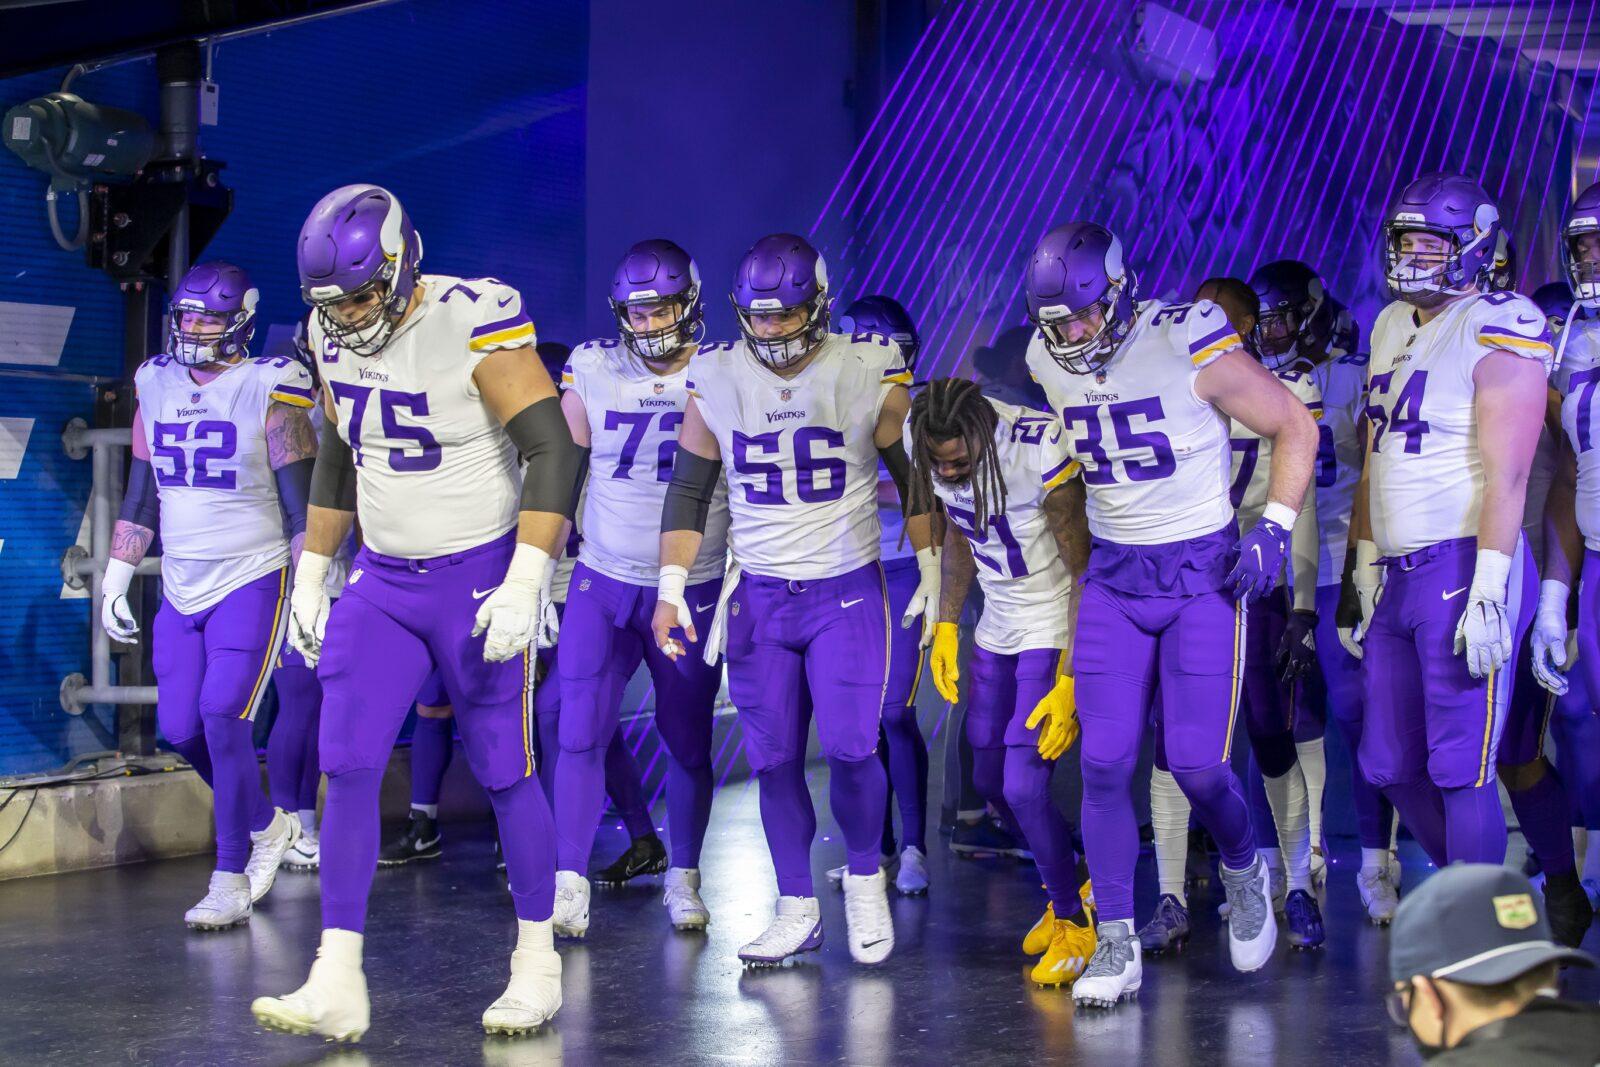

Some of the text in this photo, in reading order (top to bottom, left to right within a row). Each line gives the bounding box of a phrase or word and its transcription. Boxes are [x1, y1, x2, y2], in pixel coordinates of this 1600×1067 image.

[329, 380, 443, 472] 75
[765, 408, 806, 423] VIKINGS
[1084, 390, 1119, 404] VIKINGS
[153, 420, 238, 489] 52
[732, 426, 847, 505] 56
[1063, 395, 1177, 485] 35
